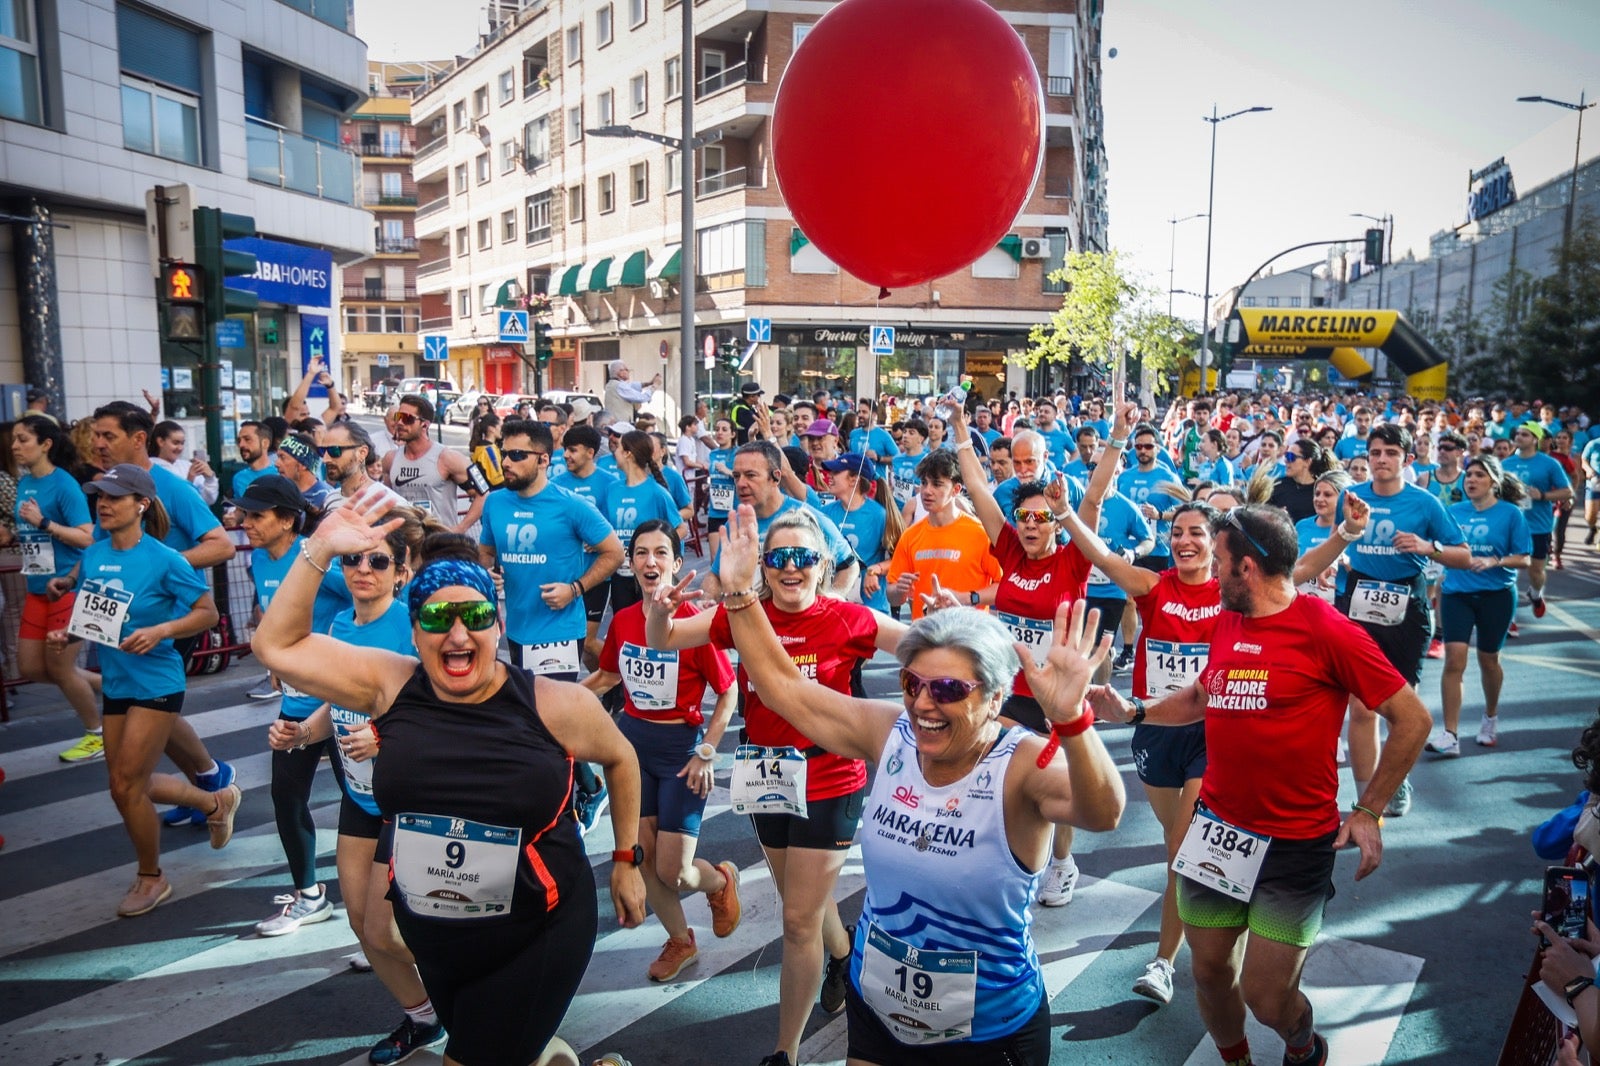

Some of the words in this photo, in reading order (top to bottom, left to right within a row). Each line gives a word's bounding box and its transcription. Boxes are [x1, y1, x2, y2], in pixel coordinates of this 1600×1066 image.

[240, 261, 327, 289] ABAHOMES
[1258, 315, 1377, 334] MARCELINO
[815, 328, 857, 342] Puerta
[712, 489, 730, 498] 2203
[616, 507, 637, 528] 18
[506, 523, 538, 553] 18
[501, 553, 547, 564] MARCELINO
[84, 593, 118, 617] 1548
[1363, 590, 1400, 606] 1383
[1161, 600, 1222, 622] MARCEINO
[625, 658, 666, 680] 1391
[1156, 653, 1200, 673] 1411
[626, 675, 647, 685] ESTRELLA
[1168, 672, 1186, 680] MARTA
[1227, 669, 1269, 681] MEMORIAL
[1225, 680, 1268, 696] PADRE
[756, 759, 783, 779] 14
[766, 780, 795, 788] ESTRELLA
[872, 804, 976, 849] MARACENA
[877, 828, 896, 840] CLUB
[897, 836, 909, 845] DE
[908, 840, 958, 857] ATISMO
[1201, 821, 1255, 859] 1384
[445, 841, 467, 870] 9
[1206, 846, 1232, 861] ANTONIO
[427, 866, 456, 881] MARÍA
[456, 871, 480, 884] JOSÉ
[894, 965, 933, 999] 19
[884, 985, 909, 1005] MARÍA
[909, 998, 942, 1012] ISABEL
